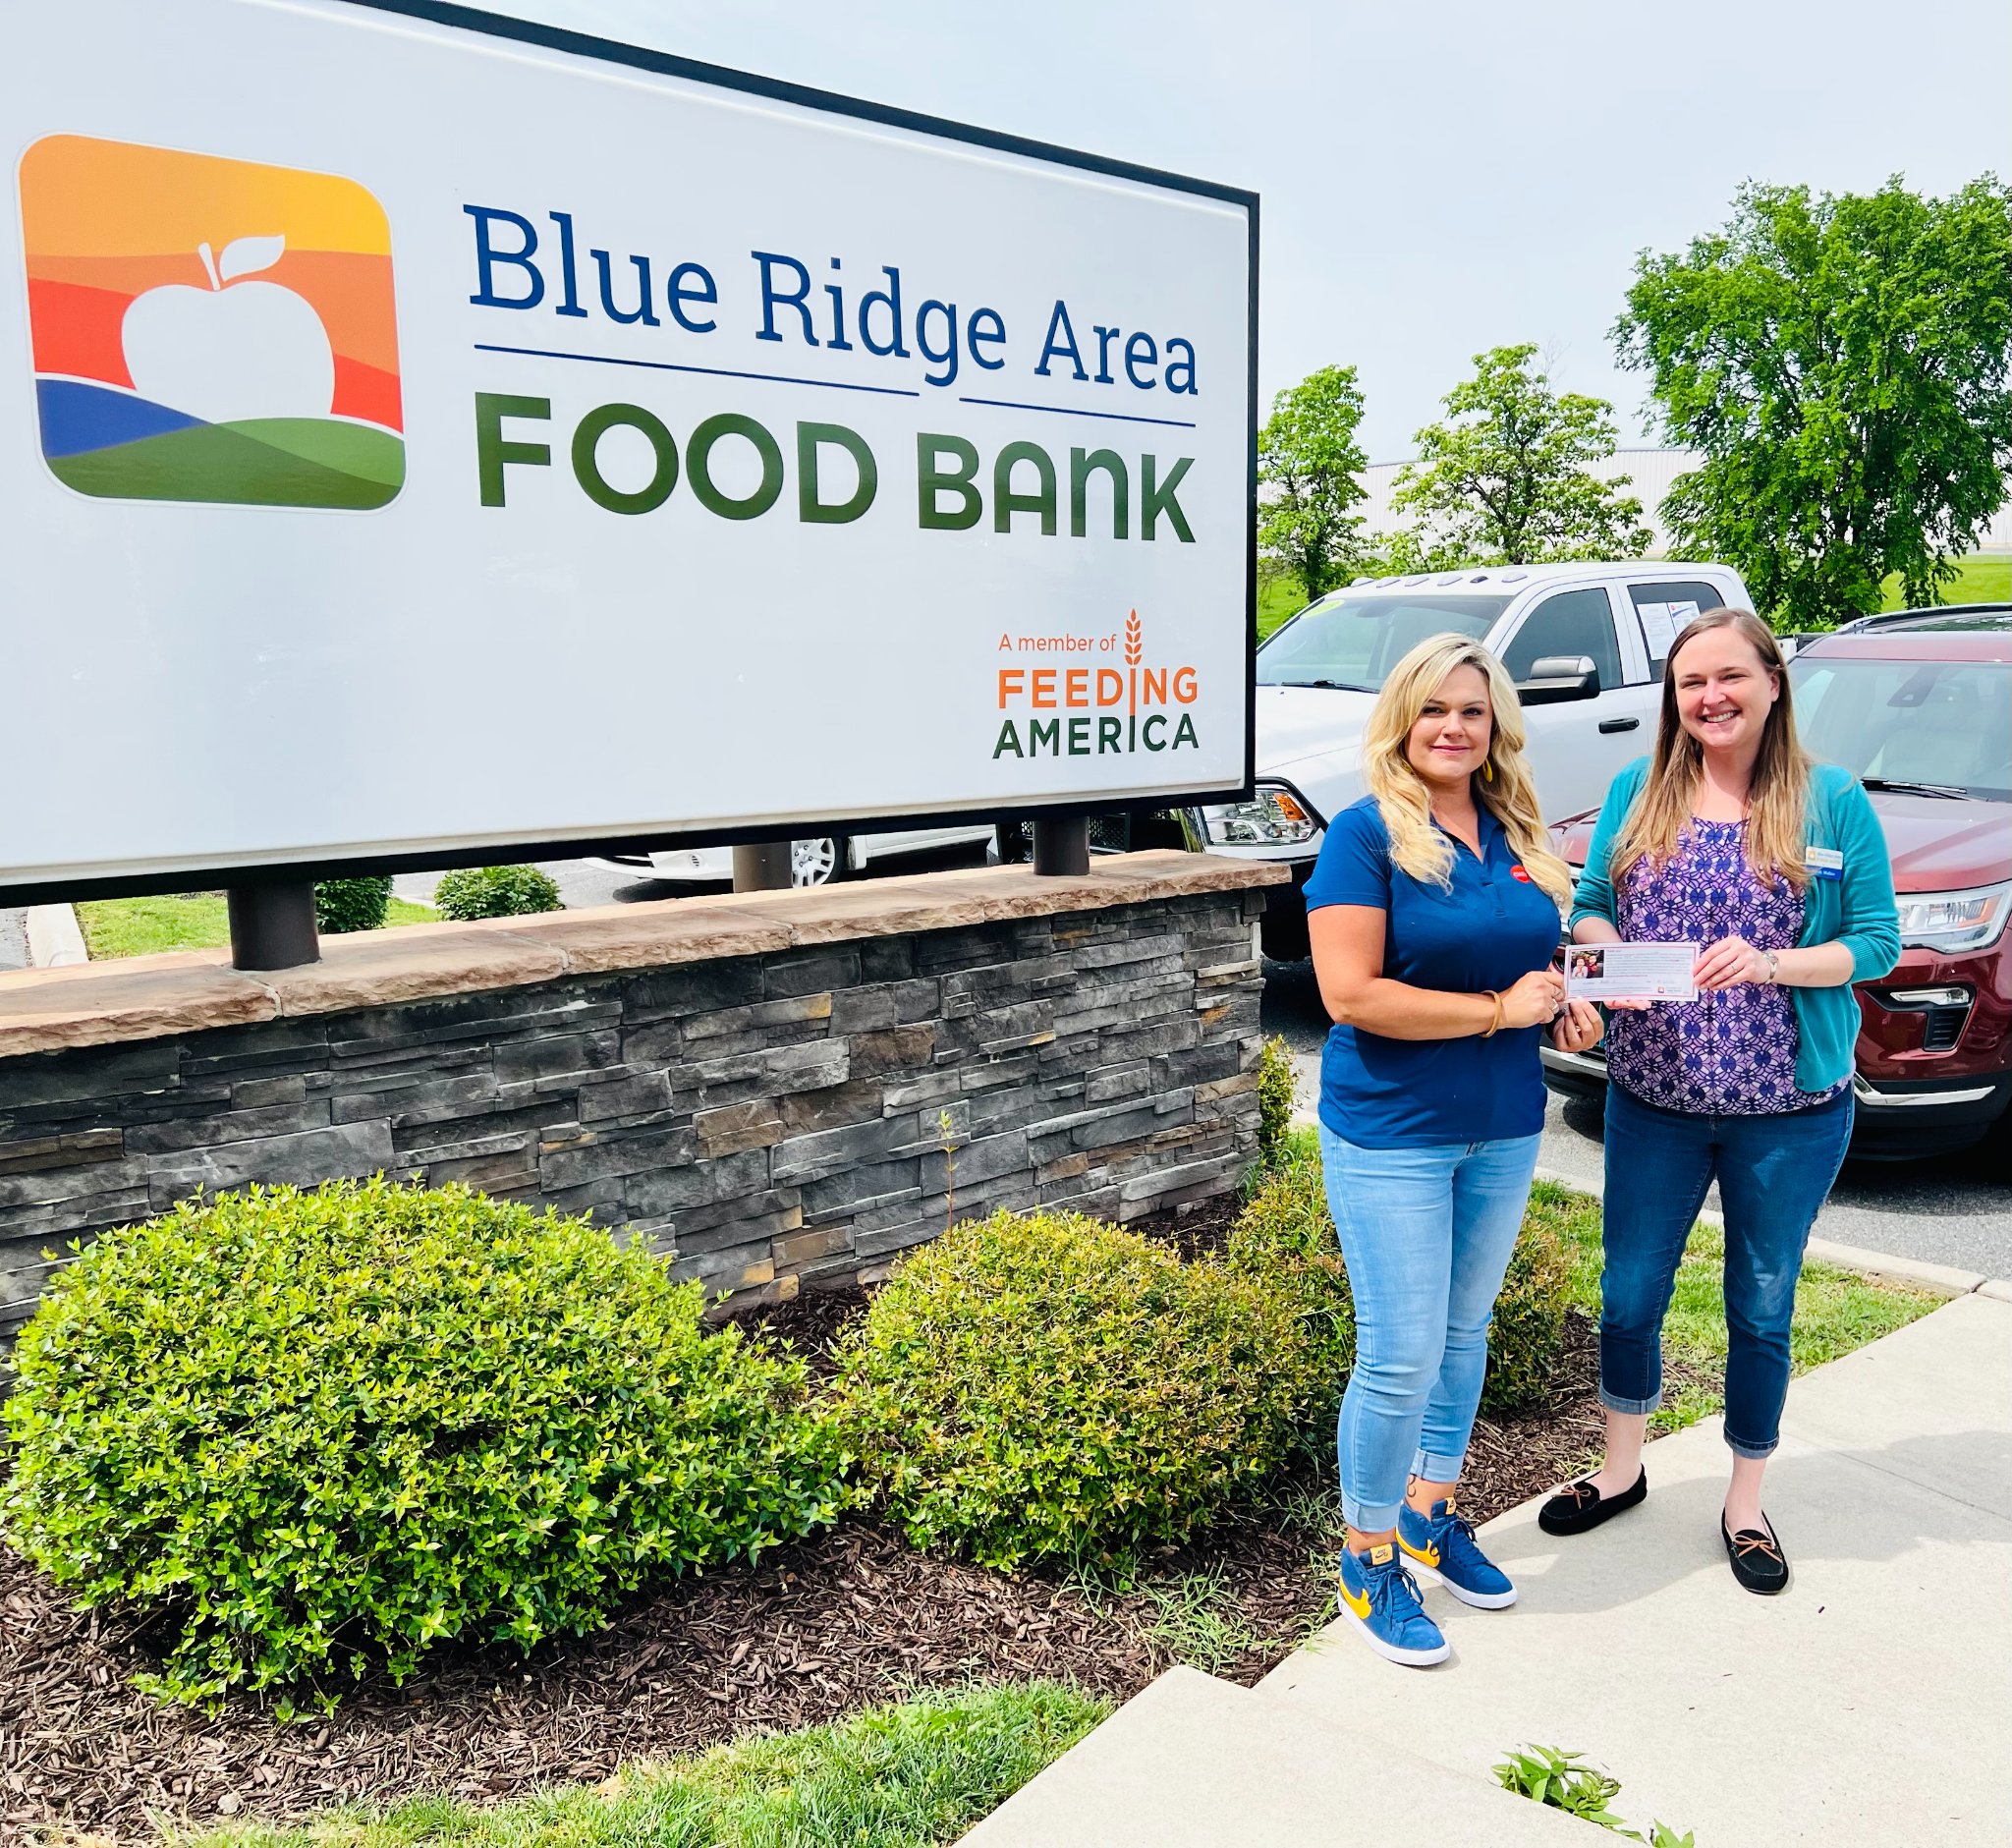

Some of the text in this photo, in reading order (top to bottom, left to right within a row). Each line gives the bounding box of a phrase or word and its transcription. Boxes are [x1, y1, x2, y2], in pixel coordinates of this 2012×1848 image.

[464, 204, 1199, 396] Blue Ridge Area
[476, 393, 1197, 543] FOOD BANK
[998, 633, 1117, 651] A member of
[998, 666, 1199, 710] FEEDING
[992, 713, 1200, 759] AMERICA
